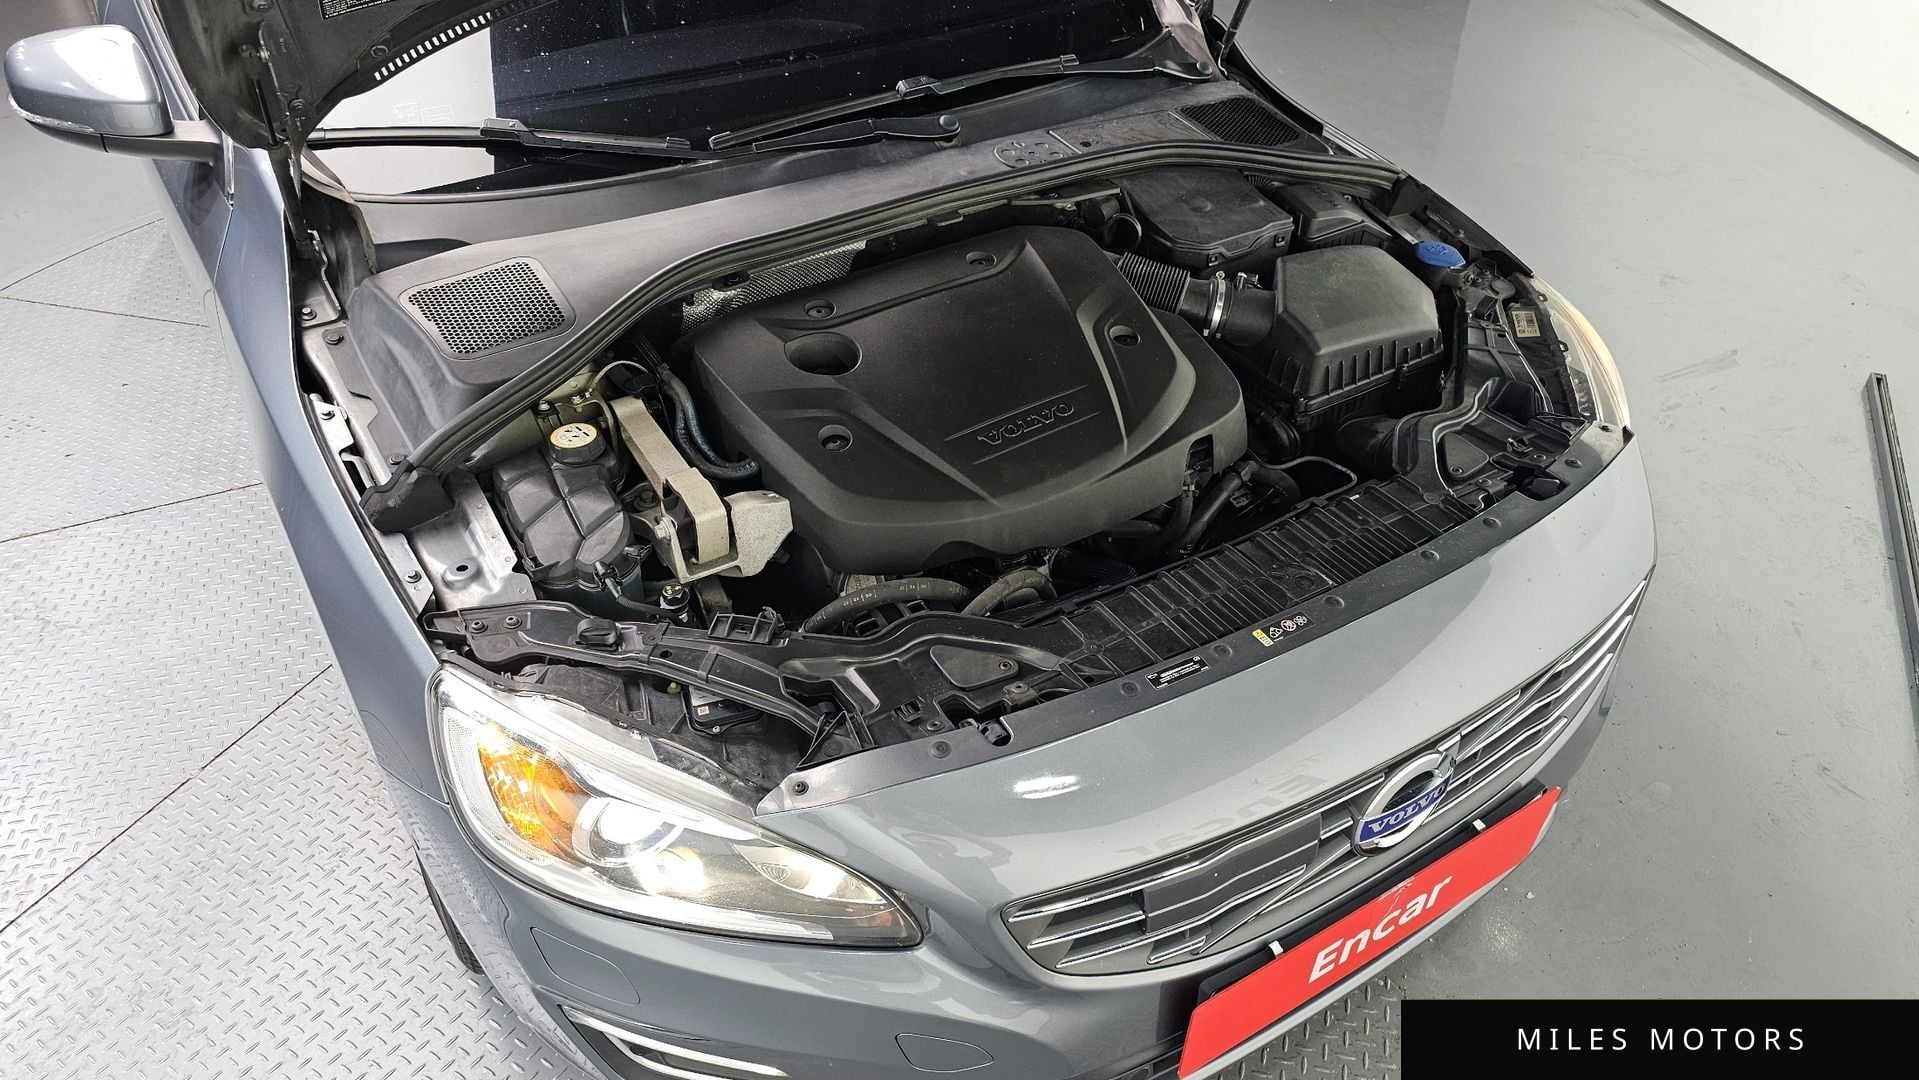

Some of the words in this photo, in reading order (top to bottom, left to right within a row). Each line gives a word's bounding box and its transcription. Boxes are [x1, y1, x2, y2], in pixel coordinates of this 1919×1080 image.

[977, 402, 1075, 445] VOLVO
[1368, 783, 1447, 833] VOLVO
[1308, 875, 1453, 984] Encar
